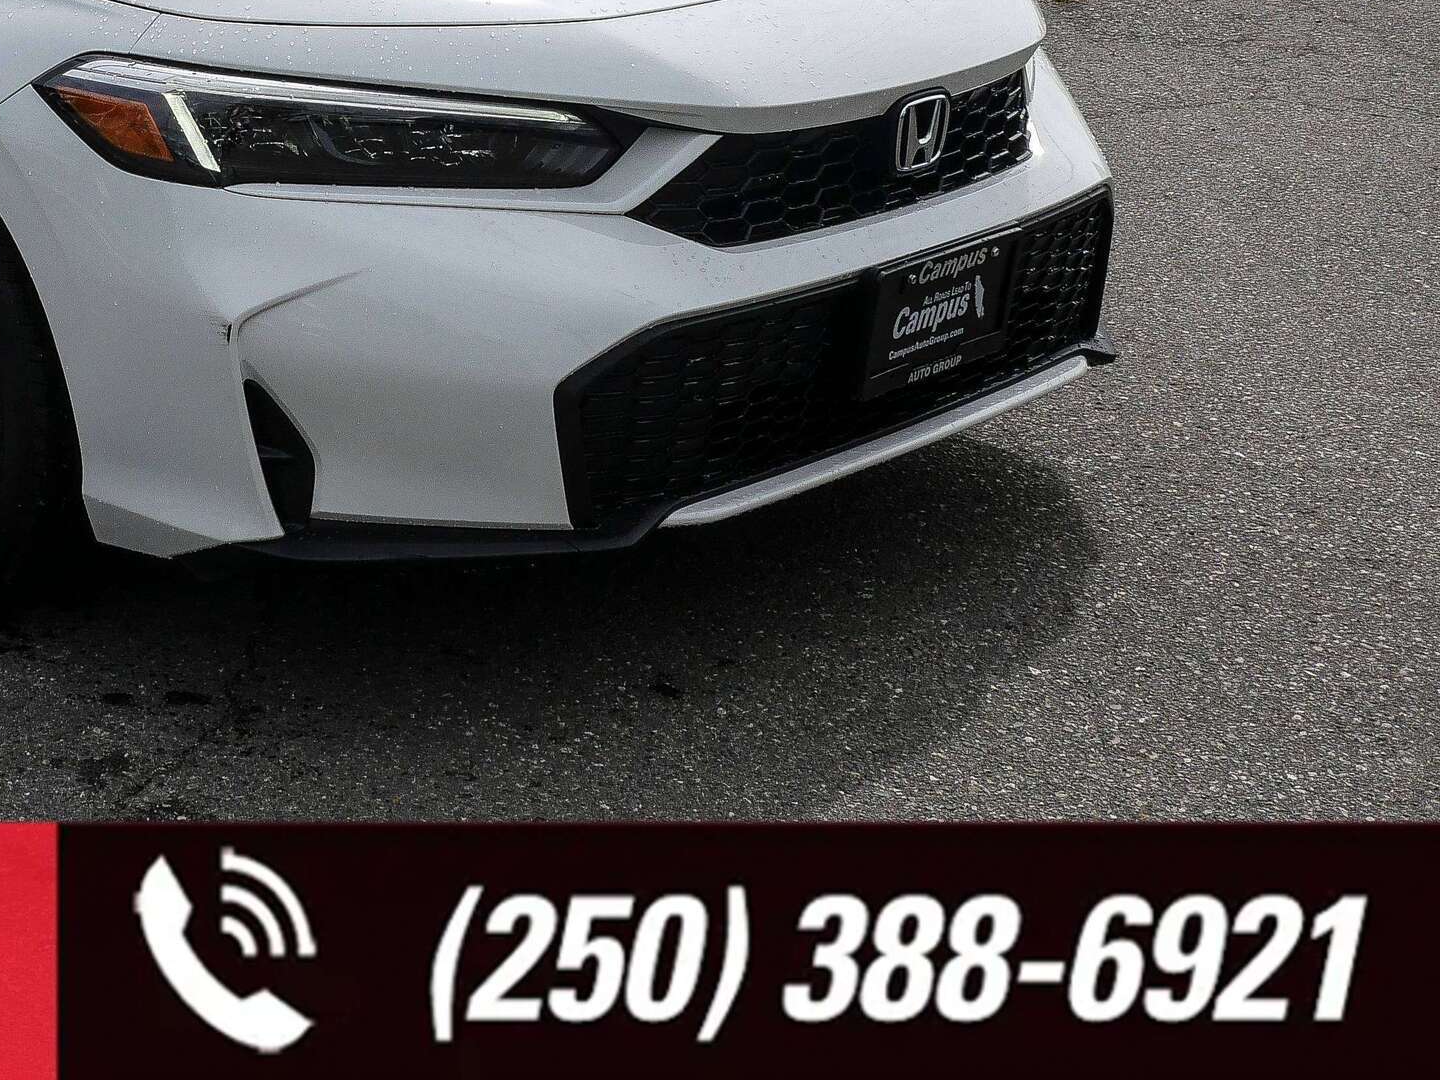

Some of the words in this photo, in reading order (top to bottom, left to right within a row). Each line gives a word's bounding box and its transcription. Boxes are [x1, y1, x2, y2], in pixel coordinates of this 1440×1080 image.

[918, 247, 988, 285] Campus
[892, 293, 970, 340] Campus
[907, 366, 931, 384] AUTO
[932, 354, 962, 375] GROUP
